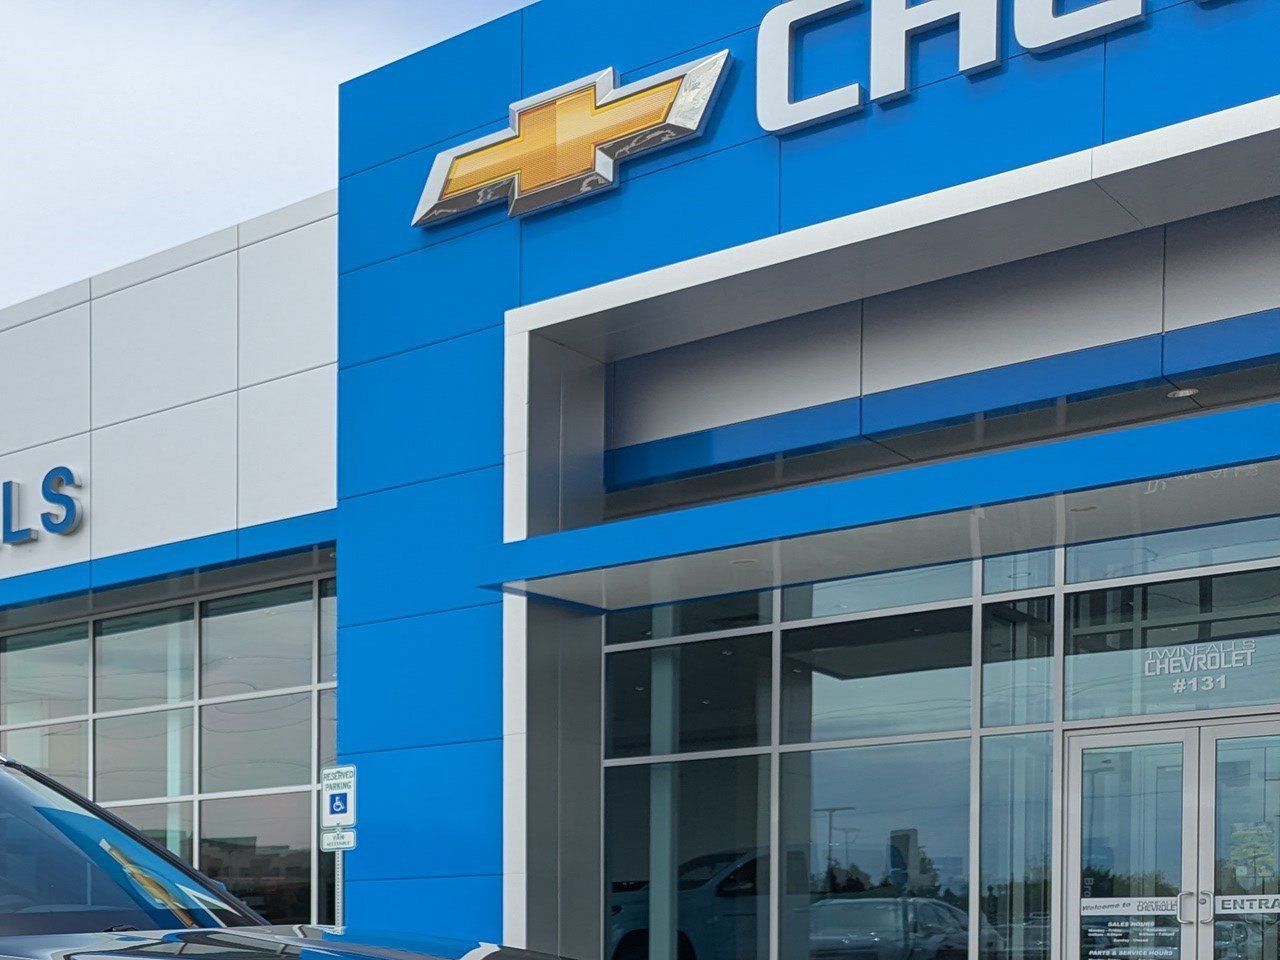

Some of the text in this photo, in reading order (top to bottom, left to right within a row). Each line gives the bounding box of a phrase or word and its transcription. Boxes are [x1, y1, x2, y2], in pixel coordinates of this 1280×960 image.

[1144, 640, 1256, 660] TWINFALLS
[1144, 649, 1256, 676] CHEVROLET
[1172, 674, 1226, 693] #131
[323, 770, 354, 781] RESERVED
[325, 781, 352, 791] PARKING
[1082, 903, 1120, 912] Welcome
